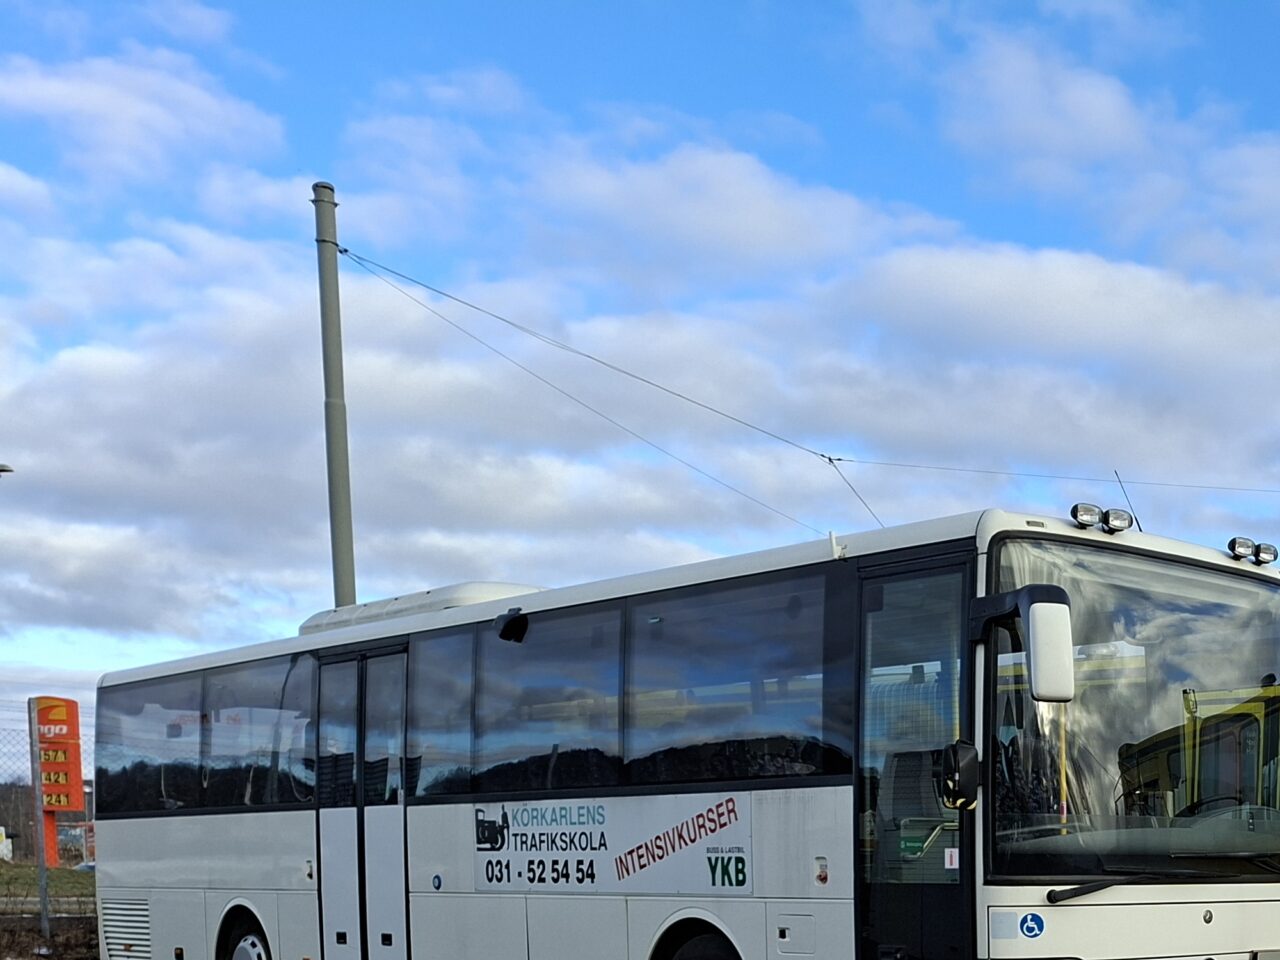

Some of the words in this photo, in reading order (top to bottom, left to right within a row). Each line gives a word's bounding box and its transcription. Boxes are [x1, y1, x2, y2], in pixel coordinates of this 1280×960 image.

[37, 724, 68, 738] ngo
[511, 803, 606, 827] KÖRKARLENS
[511, 831, 608, 852] TRAFIKSKOLA
[614, 797, 739, 881] INTENSIVKURSER
[485, 859, 511, 884] 031
[526, 859, 546, 884] 52
[550, 859, 570, 884] 54
[575, 859, 596, 884] 54
[706, 855, 747, 887] YKB
